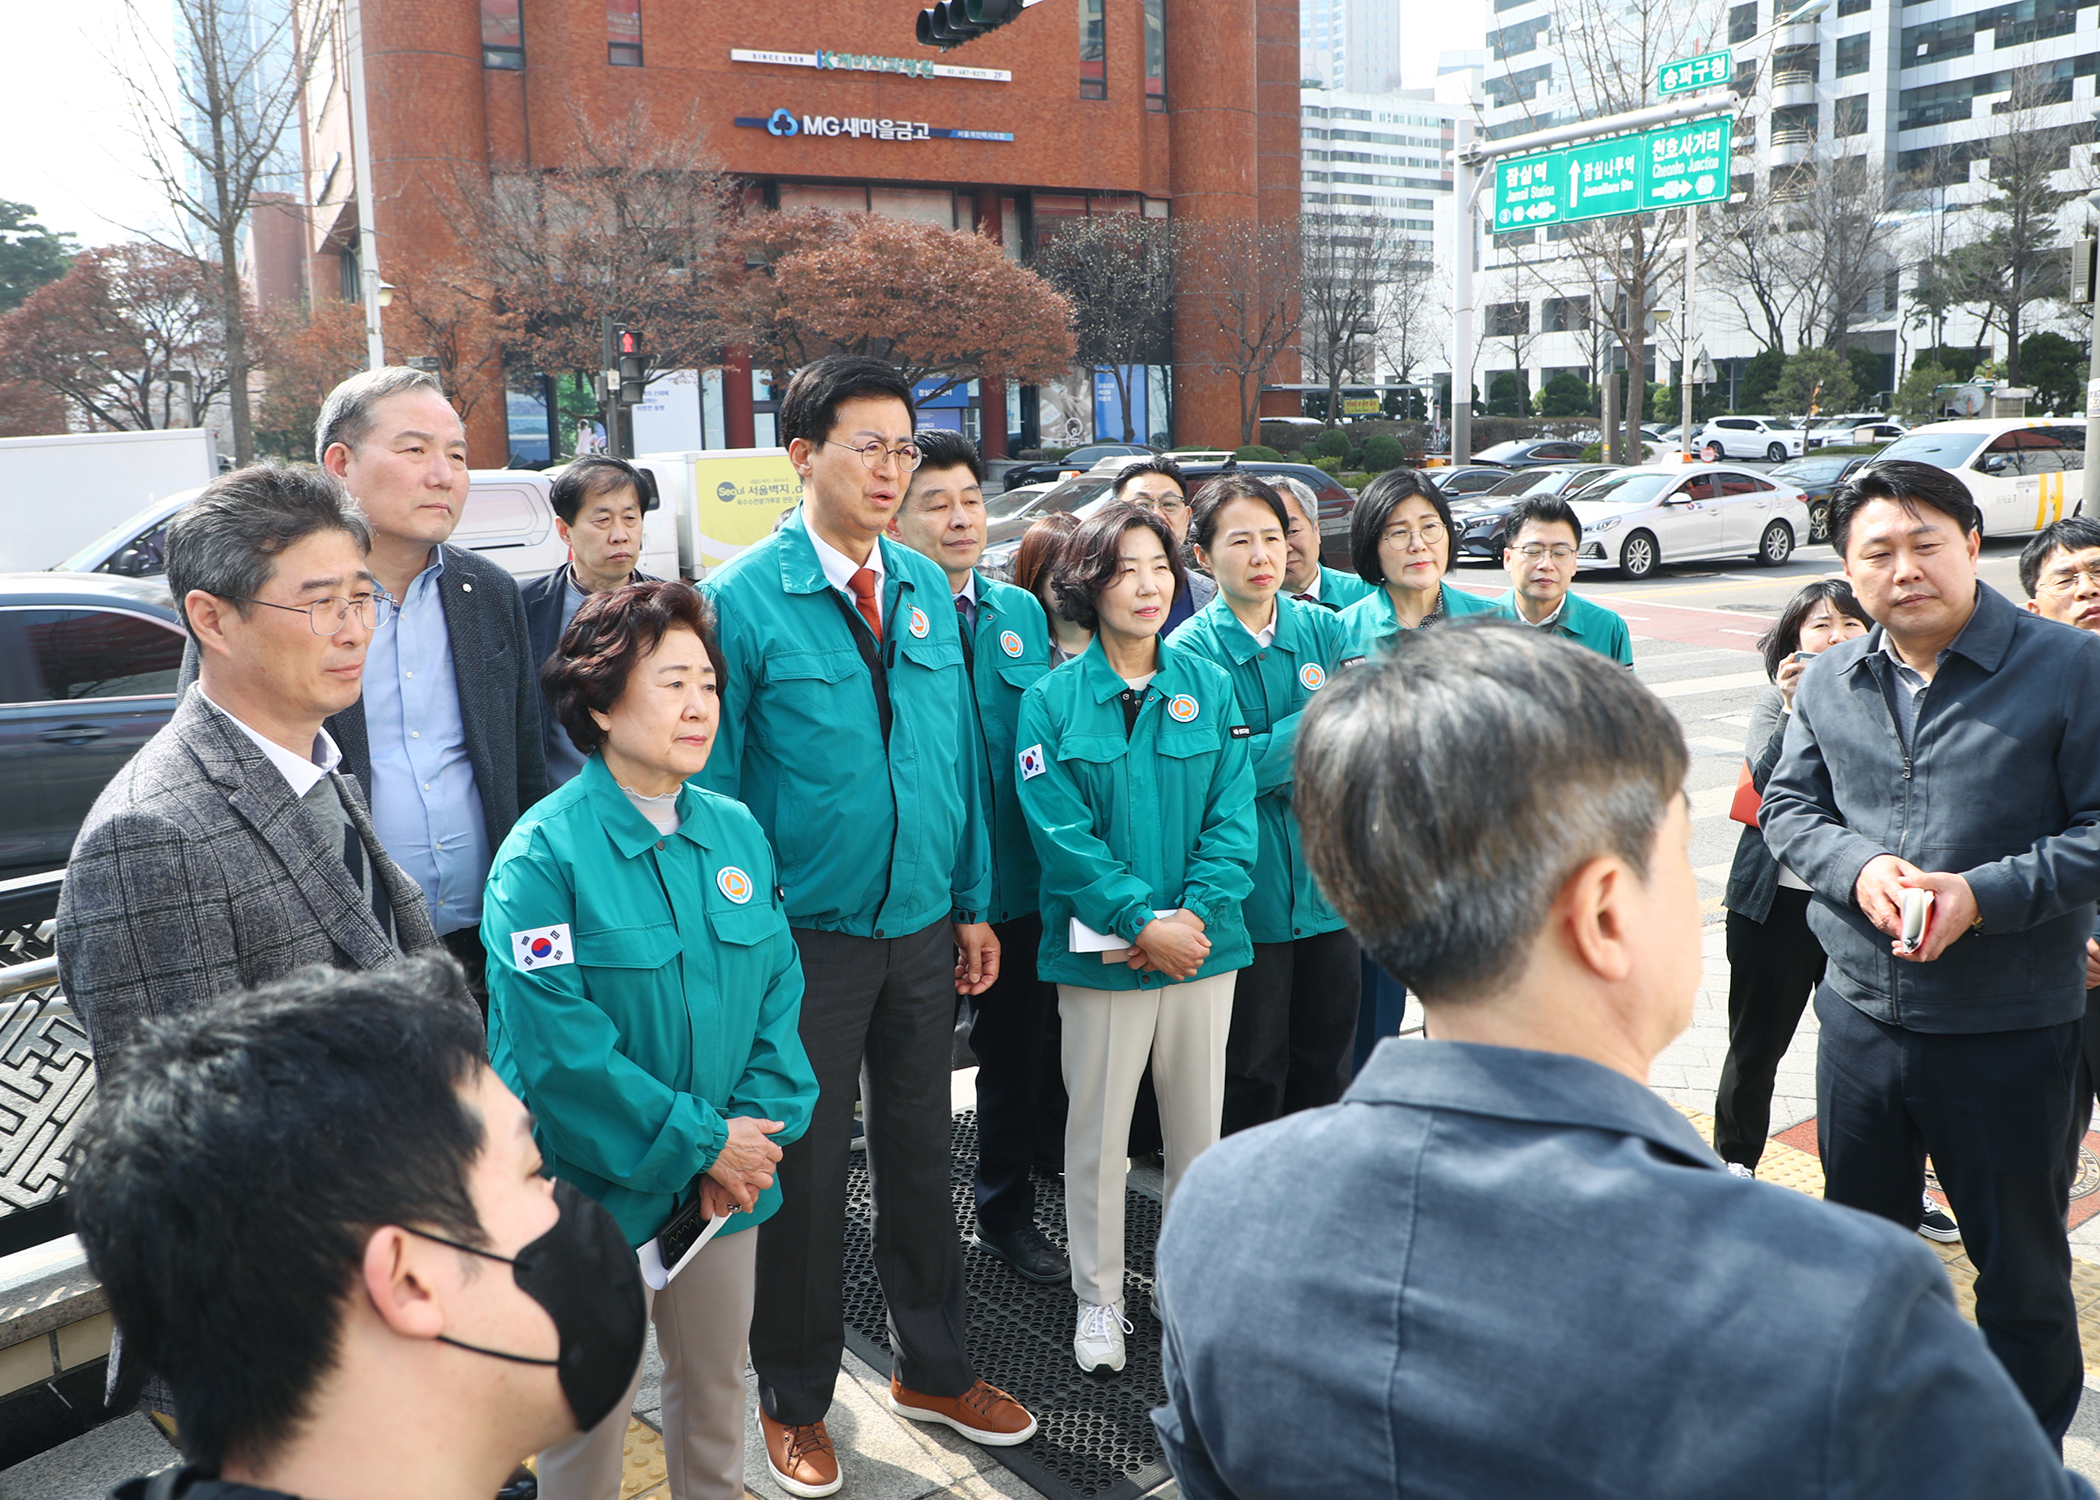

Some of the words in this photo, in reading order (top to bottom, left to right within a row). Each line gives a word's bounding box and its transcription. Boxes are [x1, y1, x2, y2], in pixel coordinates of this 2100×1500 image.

[1662, 55, 1726, 90] 송파구청
[1652, 127, 1721, 163] 천호사거리
[1505, 160, 1548, 188] 잠실역
[1583, 154, 1635, 183] 잠실나루역
[1652, 160, 1686, 179] Cheonho
[1687, 156, 1720, 173] Junction
[1506, 187, 1529, 203] Jamsil
[1530, 184, 1555, 199] Station
[718, 486, 745, 497] Seoul
